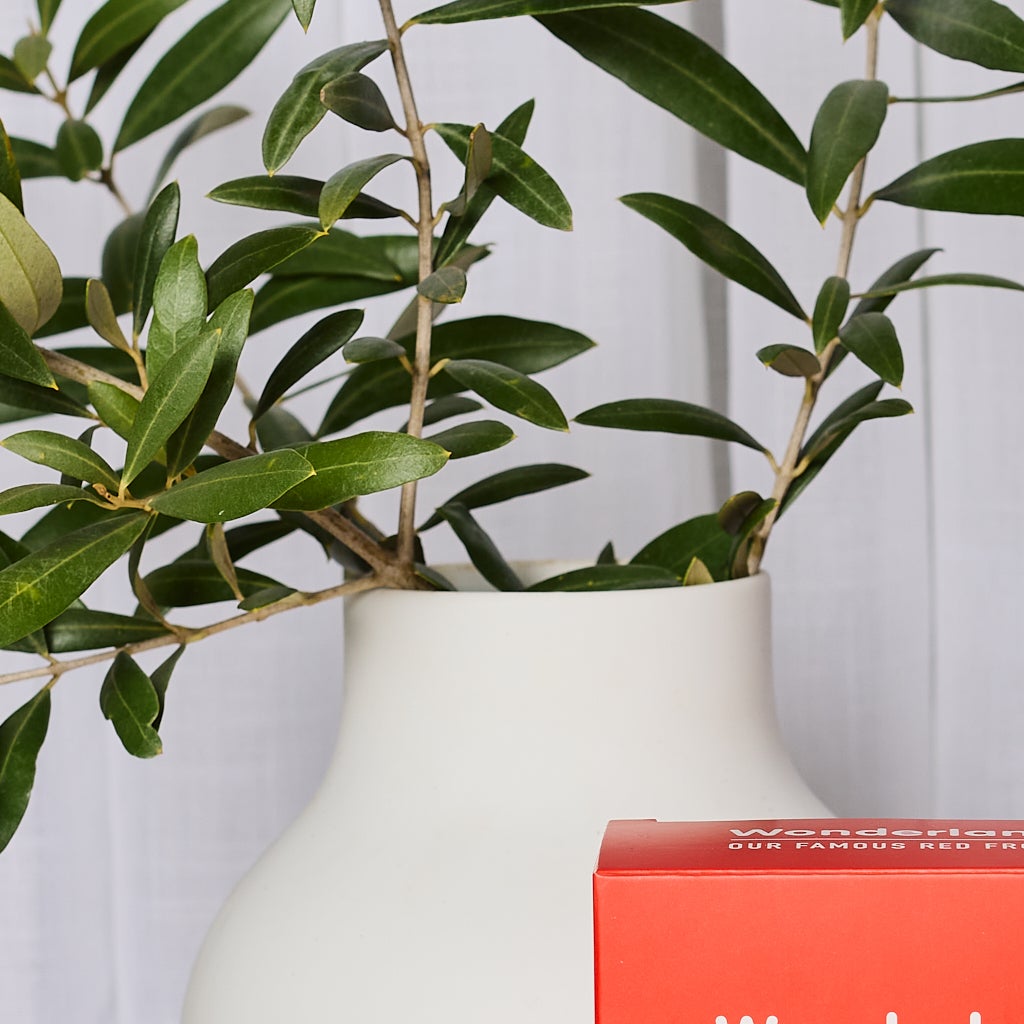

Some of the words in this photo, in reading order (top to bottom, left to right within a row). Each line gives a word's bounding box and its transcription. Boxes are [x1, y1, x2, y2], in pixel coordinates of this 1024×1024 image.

[728, 842, 782, 850] OUR
[795, 842, 906, 850] FAMOUS
[919, 842, 971, 850] RED
